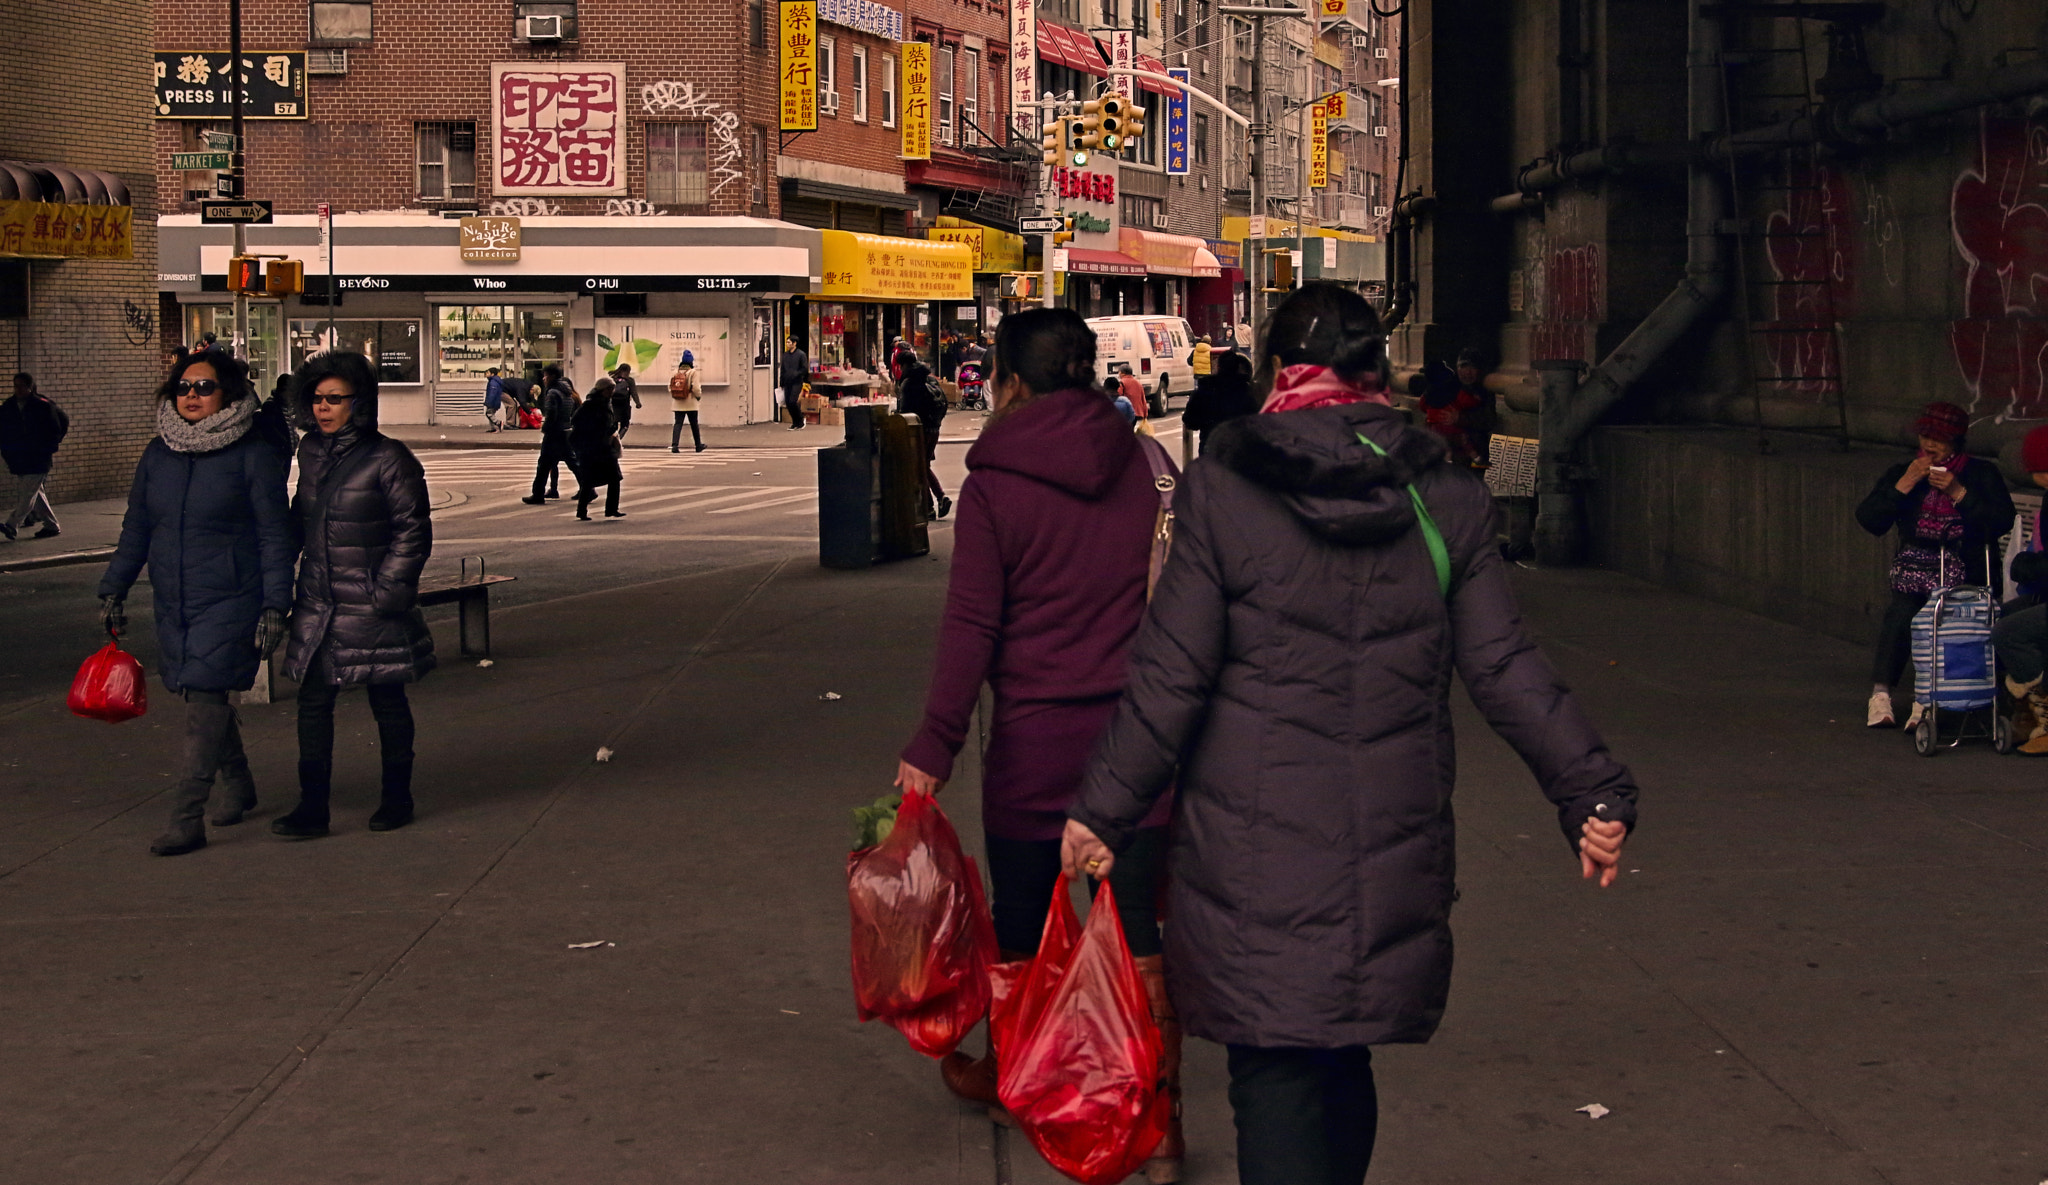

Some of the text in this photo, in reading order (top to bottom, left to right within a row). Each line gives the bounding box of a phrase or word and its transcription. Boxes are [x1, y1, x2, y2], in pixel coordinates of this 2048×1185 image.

[784, 4, 812, 86] 榮豐行
[905, 46, 927, 119] 榮豐行
[165, 90, 215, 103] PRESS
[278, 104, 293, 114] 57
[175, 154, 226, 169] MARKET ST
[211, 208, 262, 217] ONE WAY
[33, 214, 68, 240] 算命
[866, 251, 905, 267] 榮豐行
[910, 258, 967, 270] WING FUNG HONG LTD
[339, 277, 389, 288] BEYOND
[473, 278, 507, 289] Whoo
[599, 279, 618, 288] HUI
[824, 271, 853, 285] 豐行
